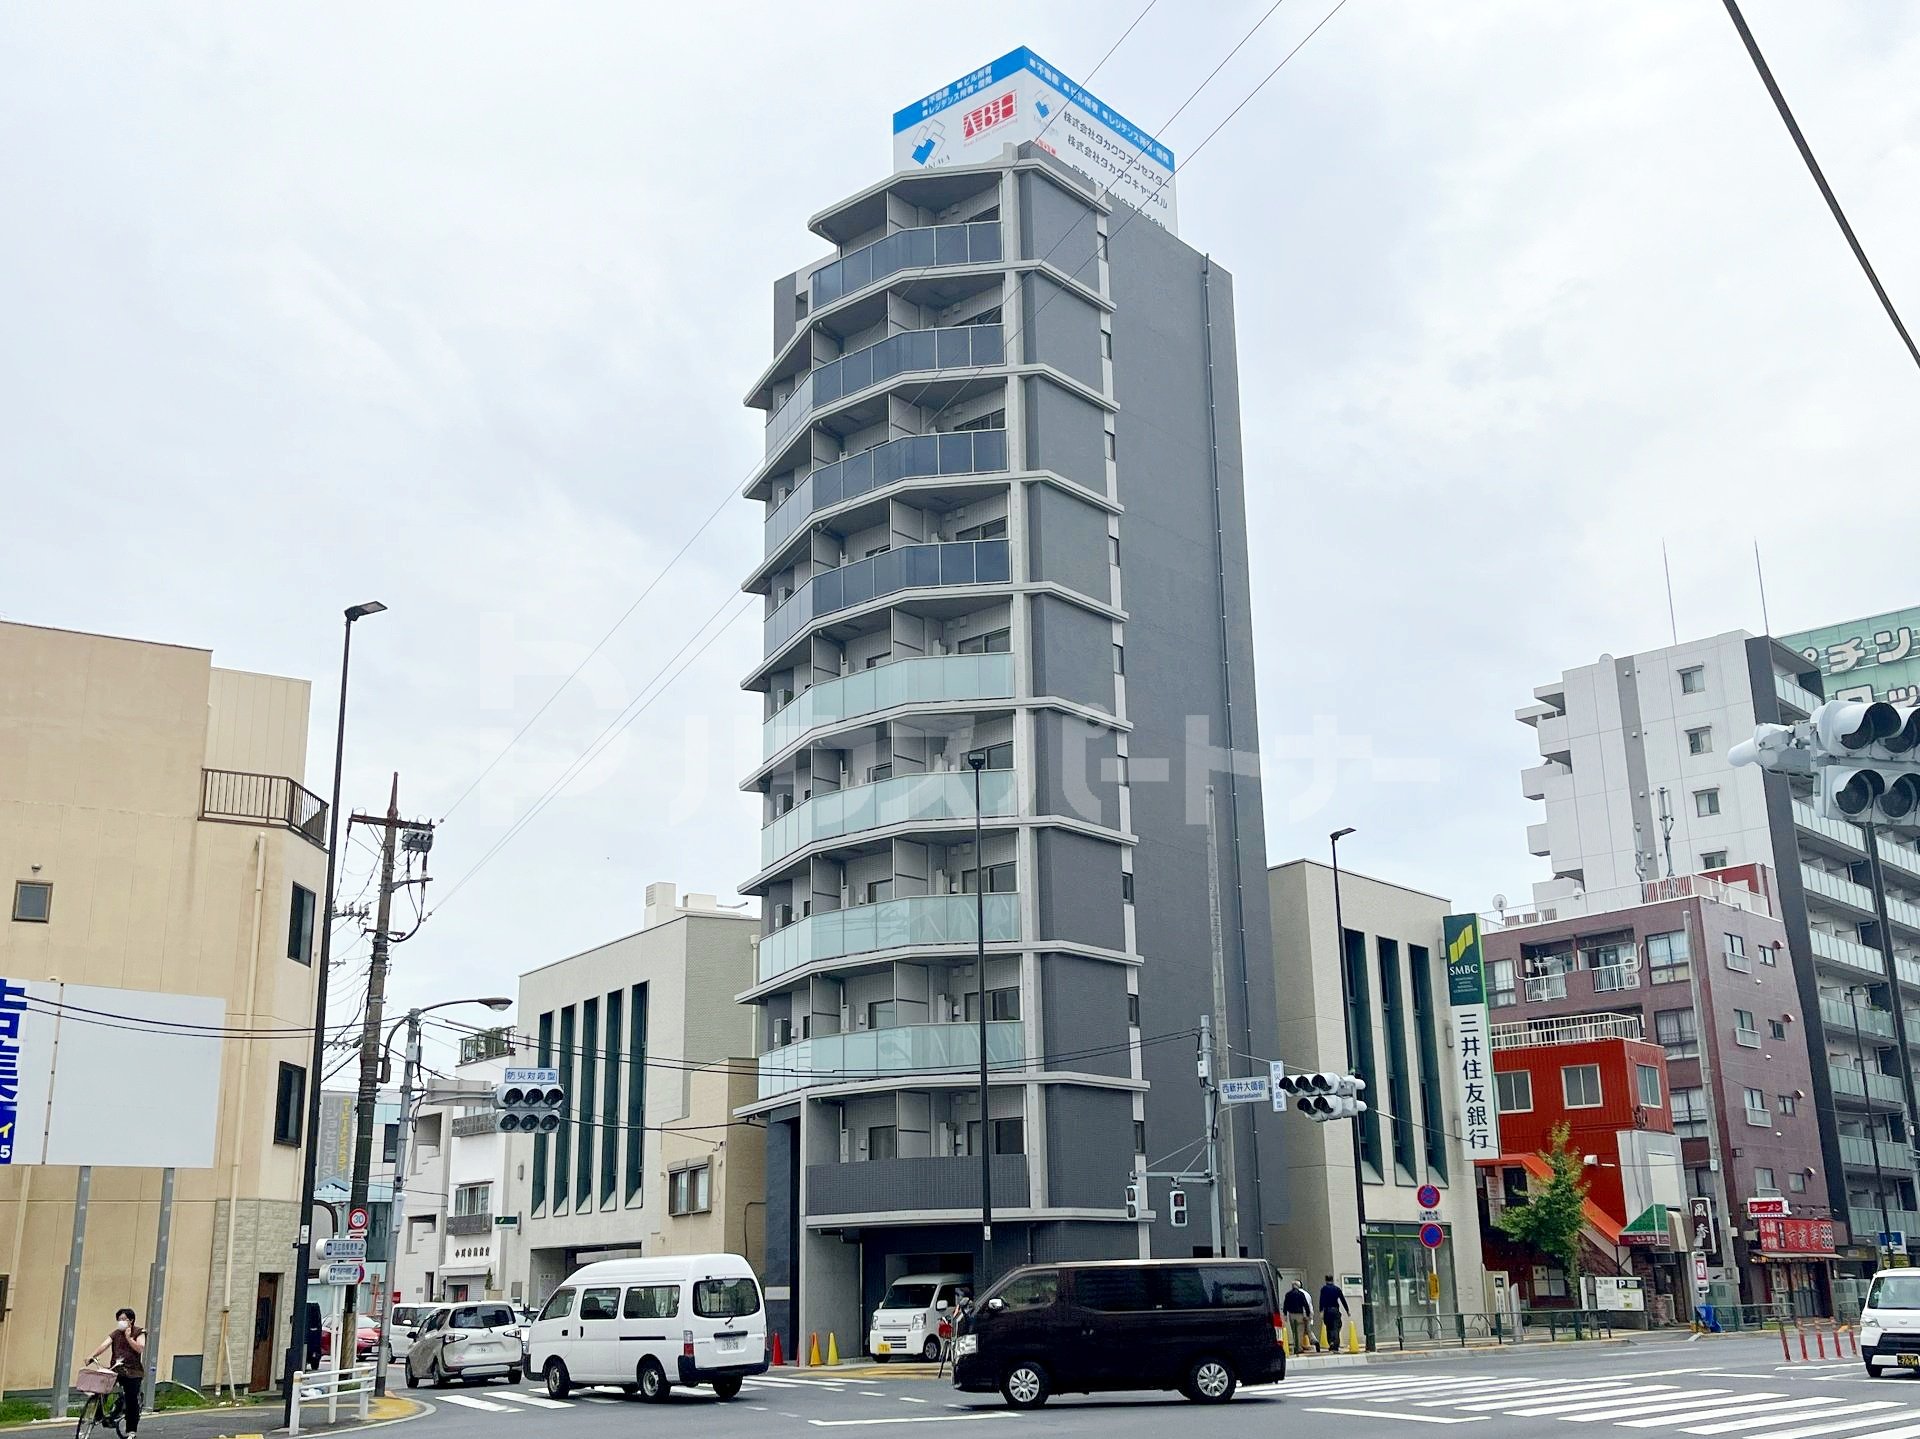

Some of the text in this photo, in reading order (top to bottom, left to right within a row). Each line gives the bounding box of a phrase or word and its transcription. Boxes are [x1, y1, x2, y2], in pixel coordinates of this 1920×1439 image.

[1802, 626, 1911, 674] チン
[1450, 964, 1478, 976] SMBC
[1459, 1013, 1489, 1149] 三井住友銀行
[1751, 1203, 1782, 1212] ラーメン
[353, 1214, 364, 1224] 30
